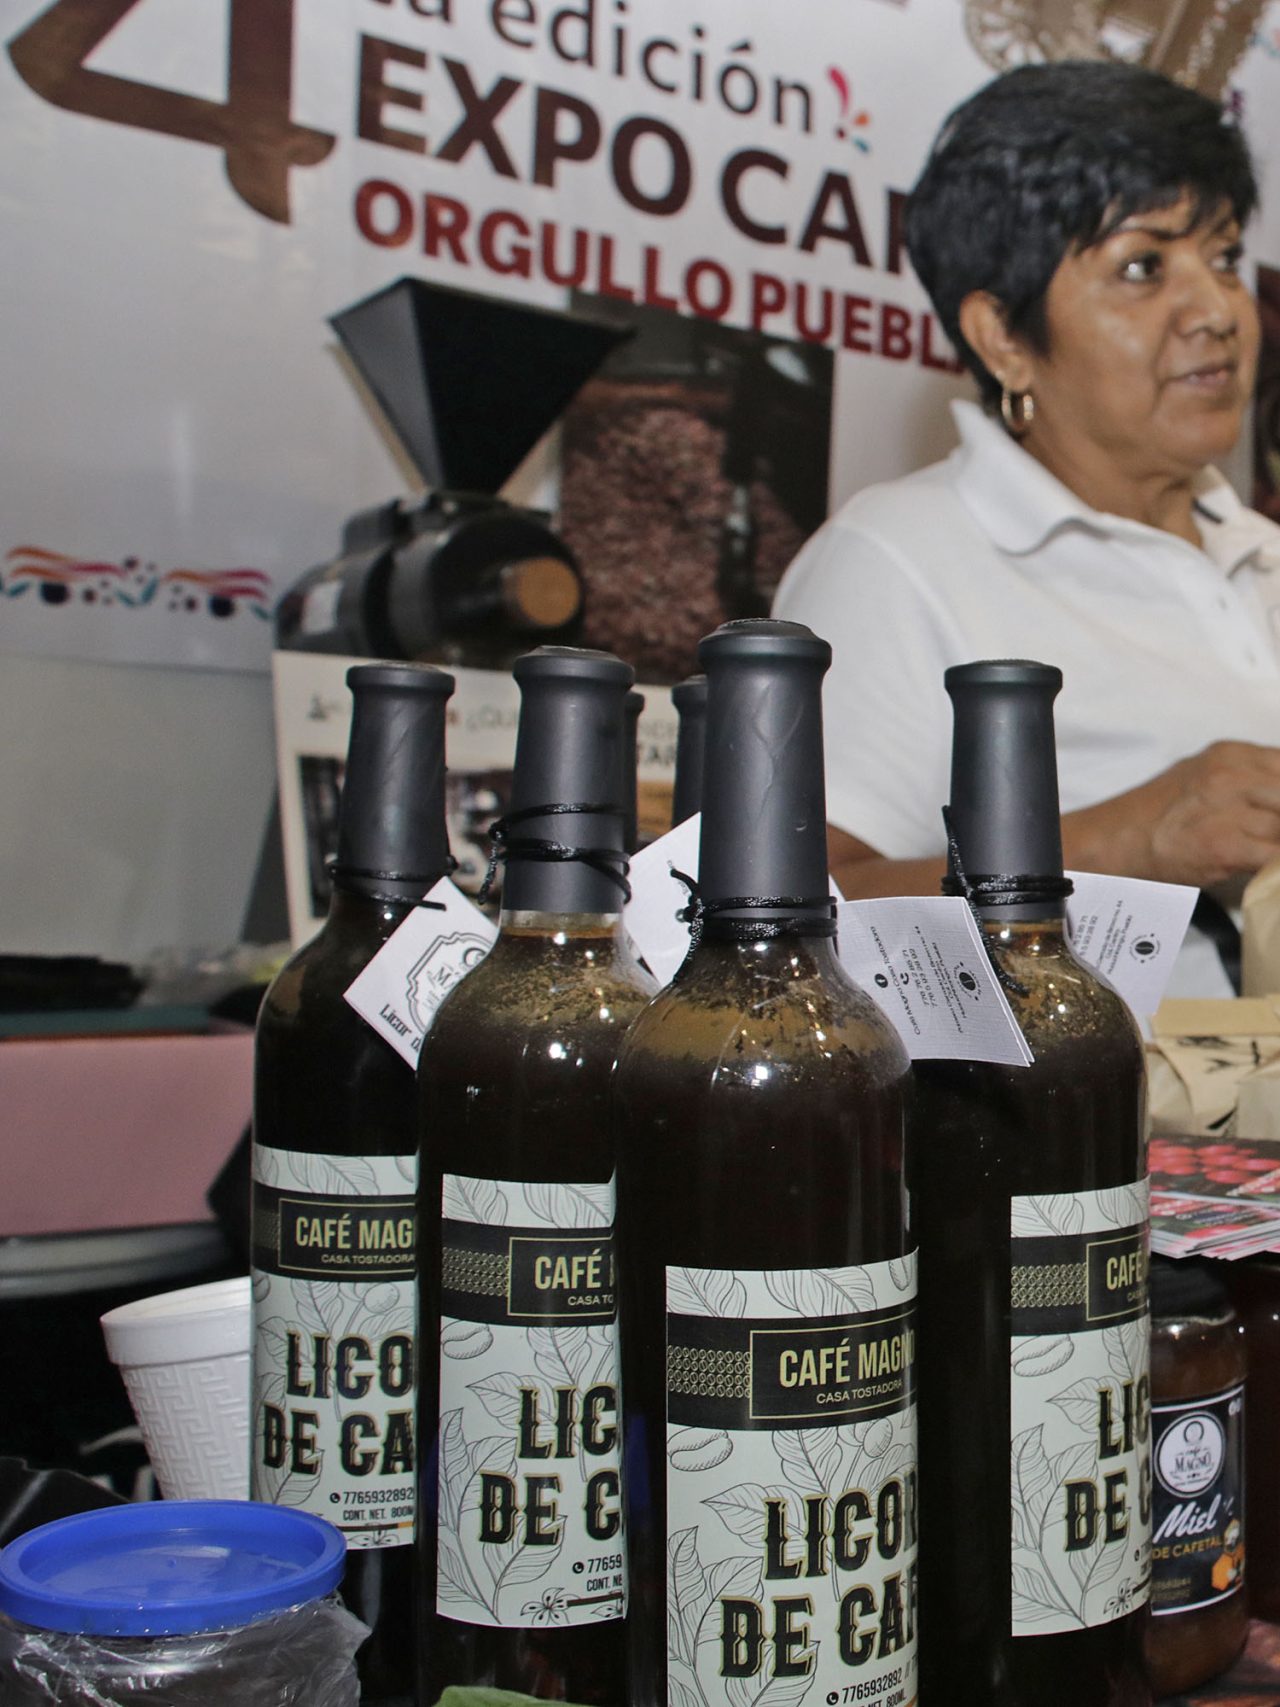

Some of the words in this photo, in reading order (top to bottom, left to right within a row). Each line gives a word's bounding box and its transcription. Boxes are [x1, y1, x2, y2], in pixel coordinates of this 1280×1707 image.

[489, 0, 815, 133] edición
[356, 31, 693, 217] EXPO
[354, 179, 732, 321] ORGULLO
[752, 269, 968, 374] PUEBL
[295, 1213, 352, 1250] CAFÉ
[358, 1217, 415, 1250] MAG
[321, 1254, 350, 1264] CASA
[534, 1247, 602, 1290] CAFÉ
[567, 1296, 601, 1306] CASA
[779, 1337, 851, 1388] CAFÉ
[816, 1391, 850, 1404] CASA
[851, 1379, 903, 1399] TOSTADORA
[262, 1402, 321, 1476] DE
[478, 1468, 564, 1546] DE
[1064, 1467, 1130, 1552] DE
[1152, 1493, 1222, 1545] Miel
[1152, 1546, 1169, 1559] DE
[1172, 1536, 1222, 1557] CAFETAL
[719, 1594, 816, 1680] DE
[842, 1667, 902, 1704] 7765932892
